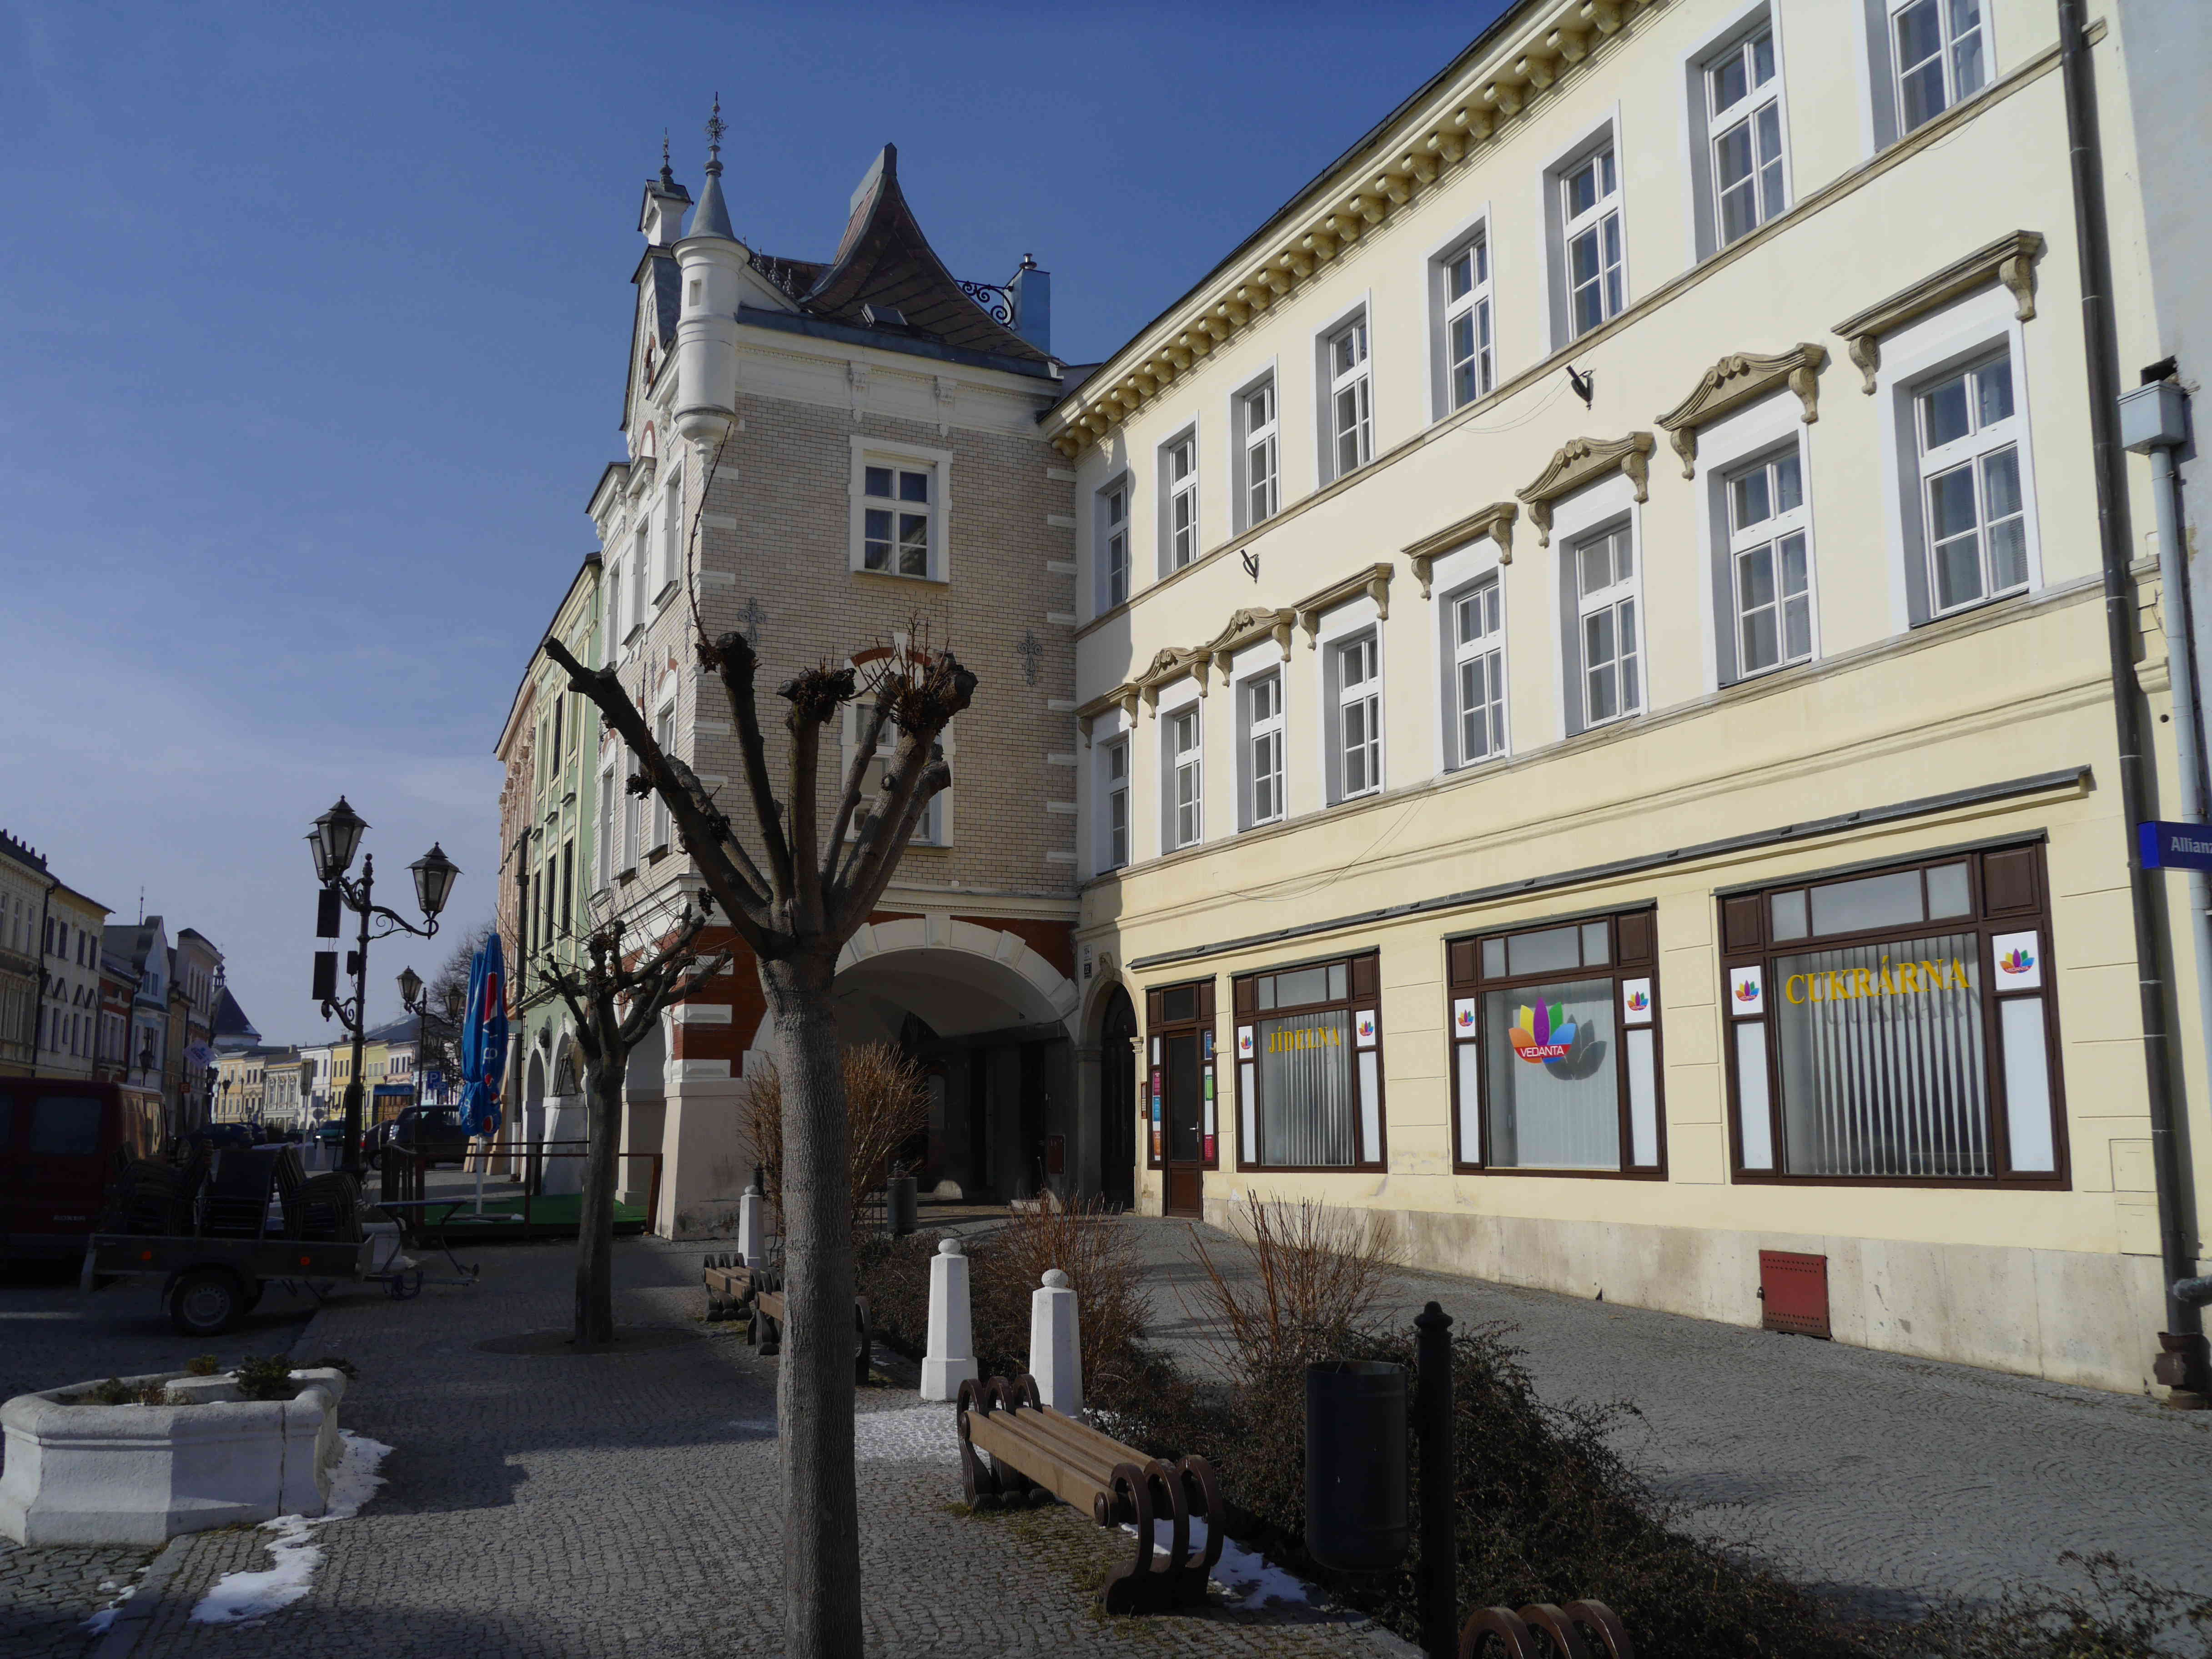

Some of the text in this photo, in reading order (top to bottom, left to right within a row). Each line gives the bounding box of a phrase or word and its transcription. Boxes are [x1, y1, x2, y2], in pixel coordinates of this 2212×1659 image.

[1785, 955, 1971, 1005] CUKRÁRNA
[1268, 1026, 1340, 1053] JÍDELNA
[1520, 1046, 1564, 1057] VEDANTA
